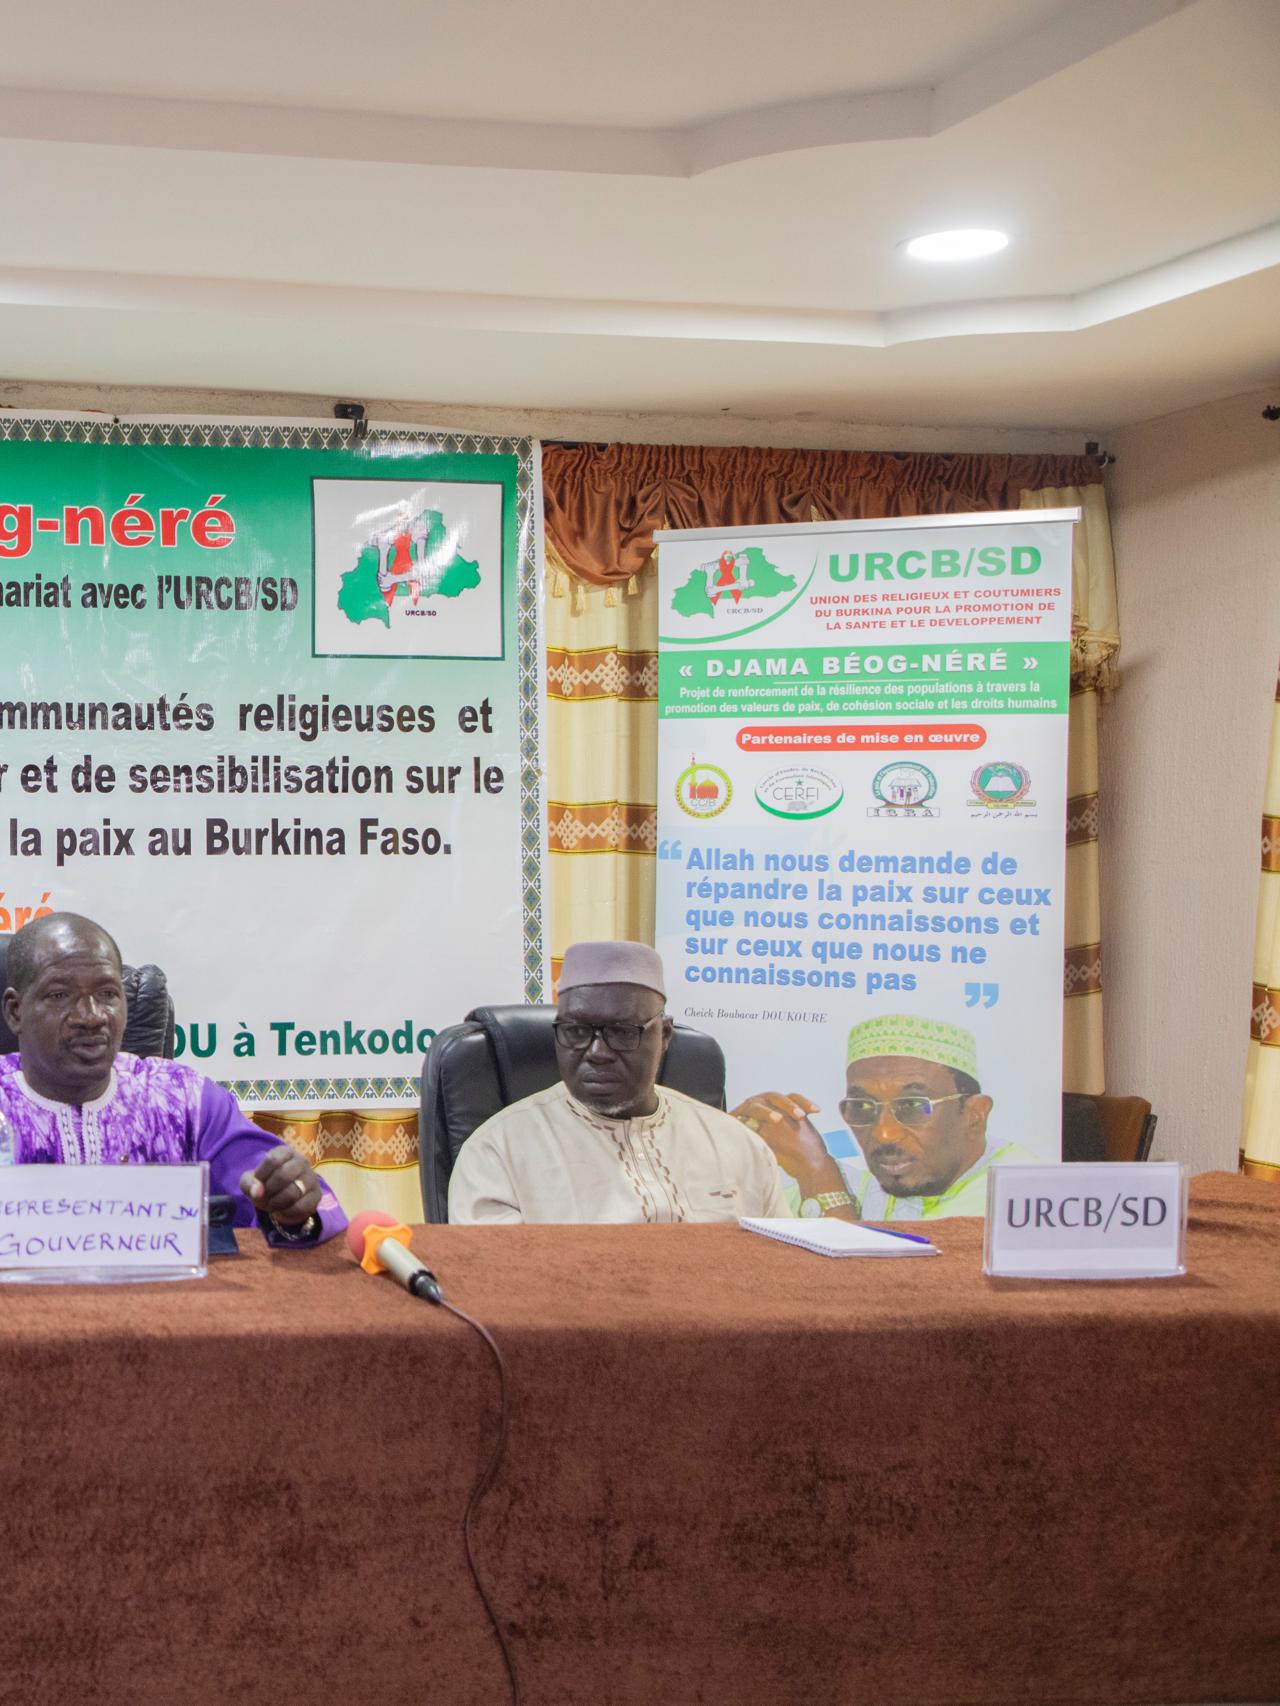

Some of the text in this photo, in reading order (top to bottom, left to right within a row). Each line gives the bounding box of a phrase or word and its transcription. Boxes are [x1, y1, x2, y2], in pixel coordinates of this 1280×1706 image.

[829, 545, 1042, 583] URCB/SD
[81, 578, 144, 610] avec
[811, 587, 1061, 605] UNION DES RELIGIEUX ET COUTUMIERS
[815, 602, 1055, 617] DU BURKINA POUR LA PROMOTION DE
[826, 616, 1042, 630] LA SANTE ET LE DEVELOPPEMENT
[707, 658, 809, 677] DJAMA
[823, 651, 1008, 675] BÉOG-NÉRÉ
[680, 682, 1039, 699] Projet de renforcement de la résilience des populations à travers la
[239, 694, 434, 741] religieuses
[459, 697, 492, 734] et
[665, 697, 1057, 715] promotion des valeurs de paix, de cohésion sociale et les droits humains
[741, 733, 979, 744] Partenaires de mise en œuvre
[20, 757, 58, 795] et
[73, 756, 116, 795] de
[129, 756, 392, 795] sensibilisation
[407, 765, 460, 795] sur
[473, 757, 504, 795] le
[772, 787, 819, 801] CERFI
[11, 818, 41, 857] la
[57, 818, 135, 866] paix
[148, 826, 190, 857] au
[206, 818, 345, 857] Burkina
[360, 818, 451, 857] Faso.
[686, 848, 1017, 875] Allah nous demande de
[686, 877, 1052, 906] répandre la paix sur ceux
[686, 909, 1039, 936] que nous connaissons et
[685, 937, 986, 964] sur ceux que nous ne
[684, 963, 917, 994] connaissons pas
[717, 1009, 758, 1020] Boubacar
[233, 1022, 256, 1057] à
[270, 1020, 437, 1056] Tenkodo
[1007, 1193, 1167, 1233] URCB/SD
